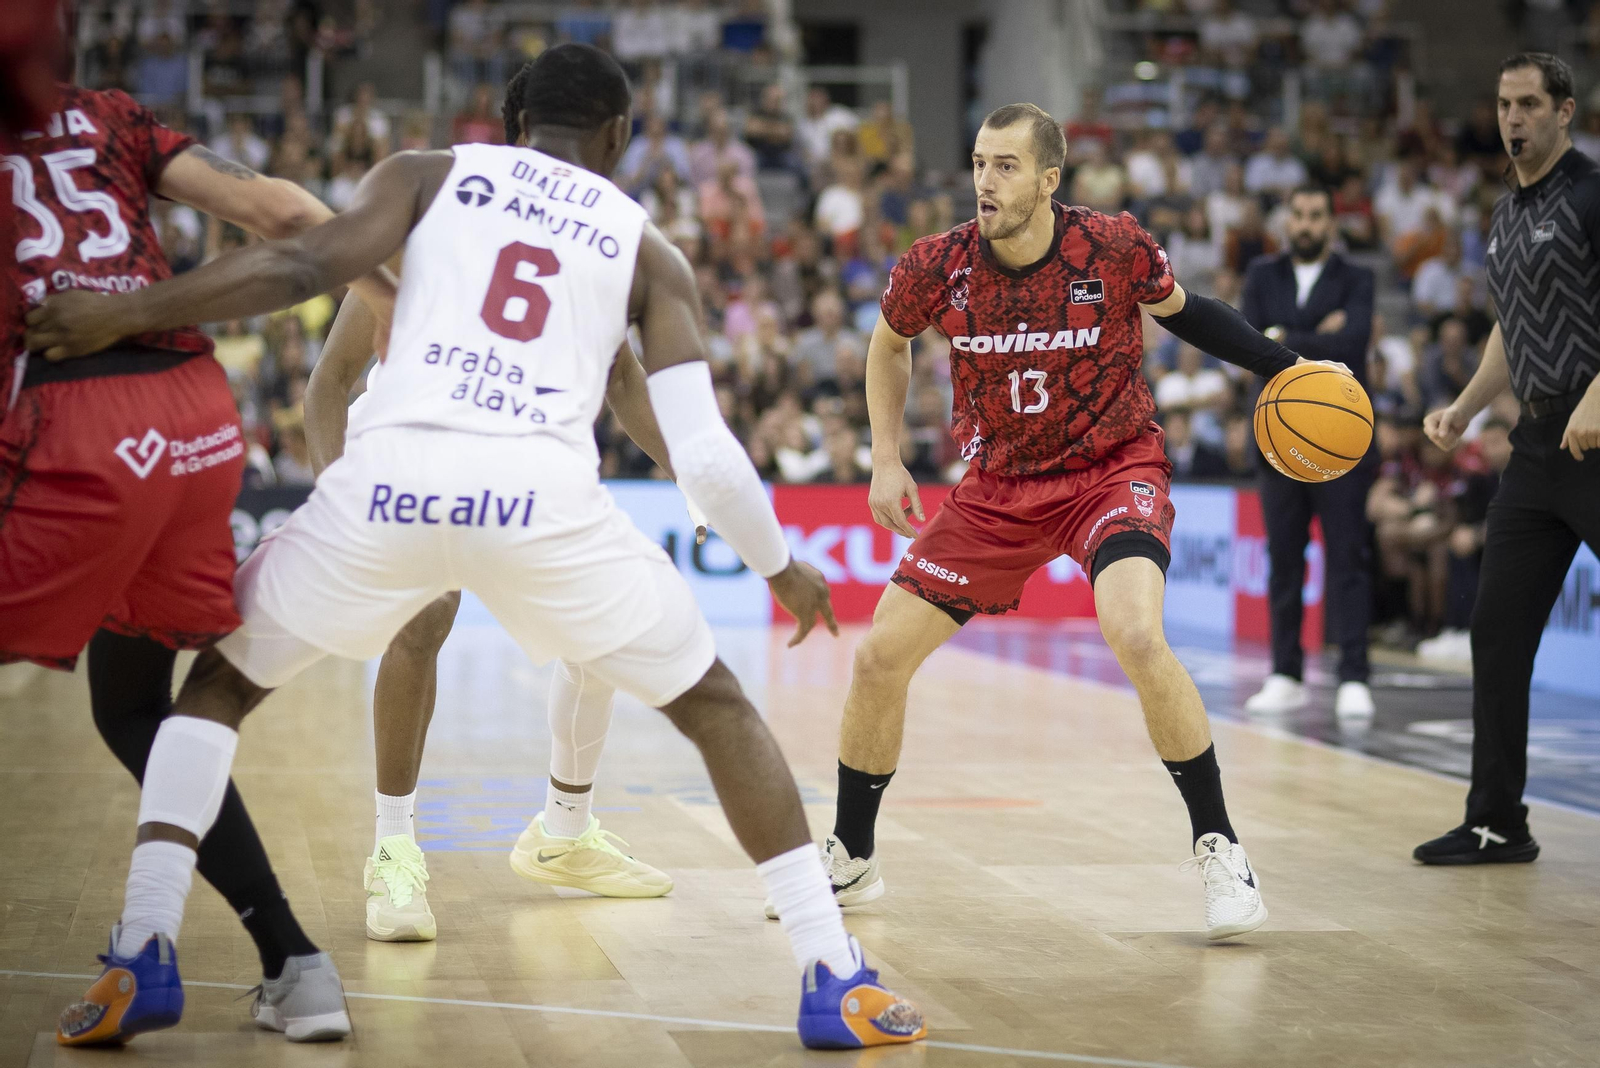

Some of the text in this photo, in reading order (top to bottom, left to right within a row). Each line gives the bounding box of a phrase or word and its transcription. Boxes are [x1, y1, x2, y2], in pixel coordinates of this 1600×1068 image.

[0, 148, 131, 263] 35
[511, 160, 602, 208] DIALLO
[503, 196, 620, 259] AMUTIO
[480, 240, 561, 343] 6
[1073, 292, 1102, 302] endesa
[423, 342, 525, 385] araba
[450, 375, 548, 424] álava
[1008, 367, 1049, 414] 13
[1132, 485, 1150, 494] acb
